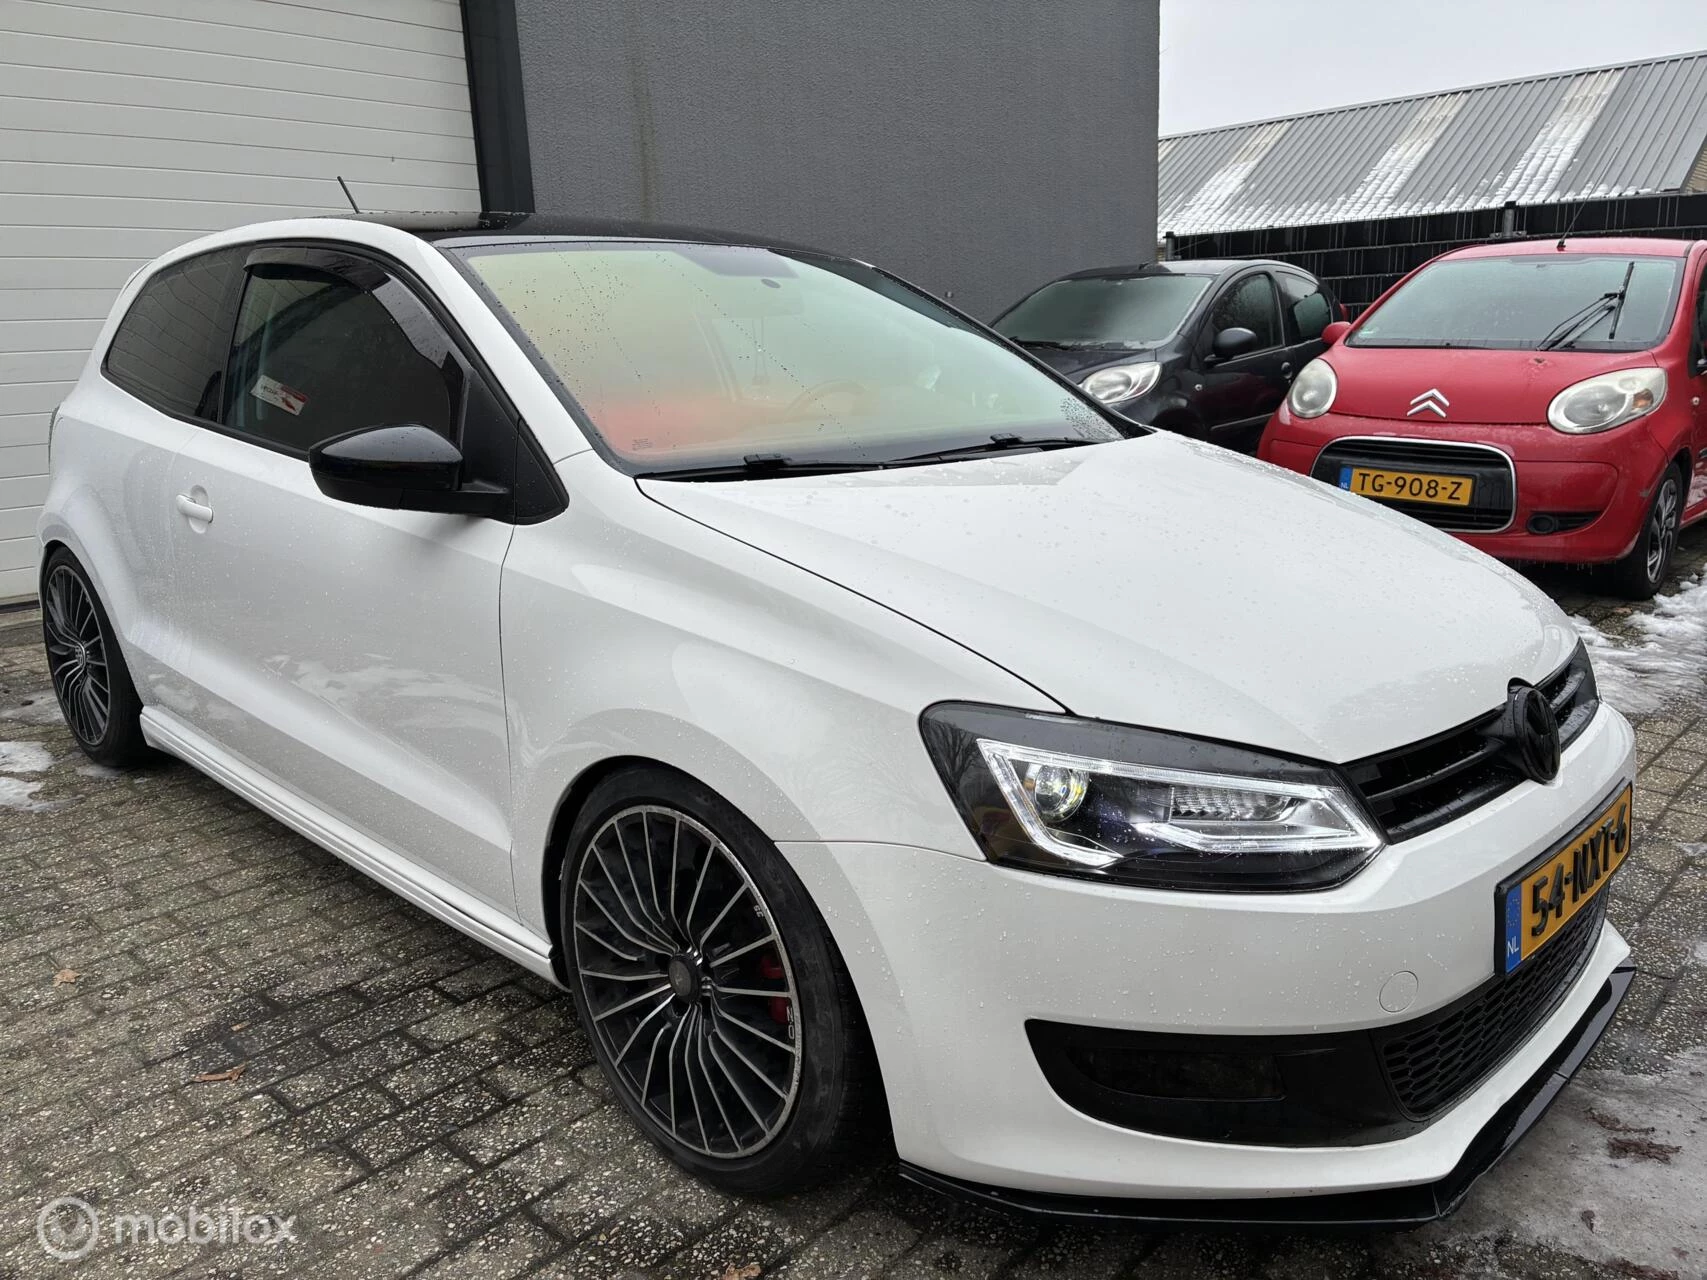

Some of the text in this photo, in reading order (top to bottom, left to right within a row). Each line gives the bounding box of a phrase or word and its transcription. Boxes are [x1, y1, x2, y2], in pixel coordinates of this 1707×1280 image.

[1359, 472, 1463, 501] TG-908-Z
[1531, 803, 1627, 937] 54-NXT-6
[1506, 937, 1520, 958] NL
